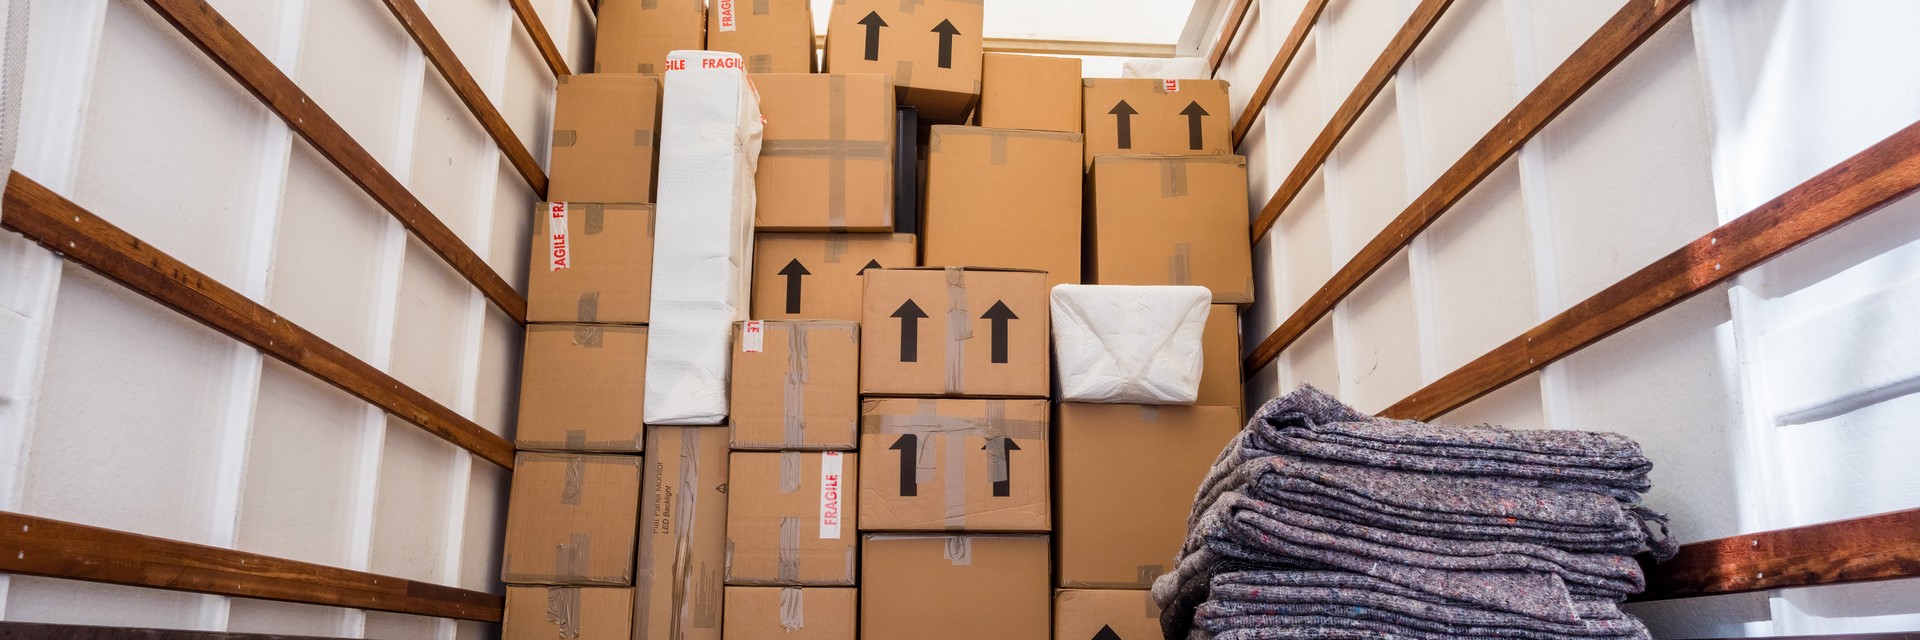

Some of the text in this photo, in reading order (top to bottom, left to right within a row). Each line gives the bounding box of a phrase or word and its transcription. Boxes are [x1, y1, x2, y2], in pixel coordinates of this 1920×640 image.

[662, 485, 673, 535] LED Backlight
[824, 474, 839, 526] FRAGILE
